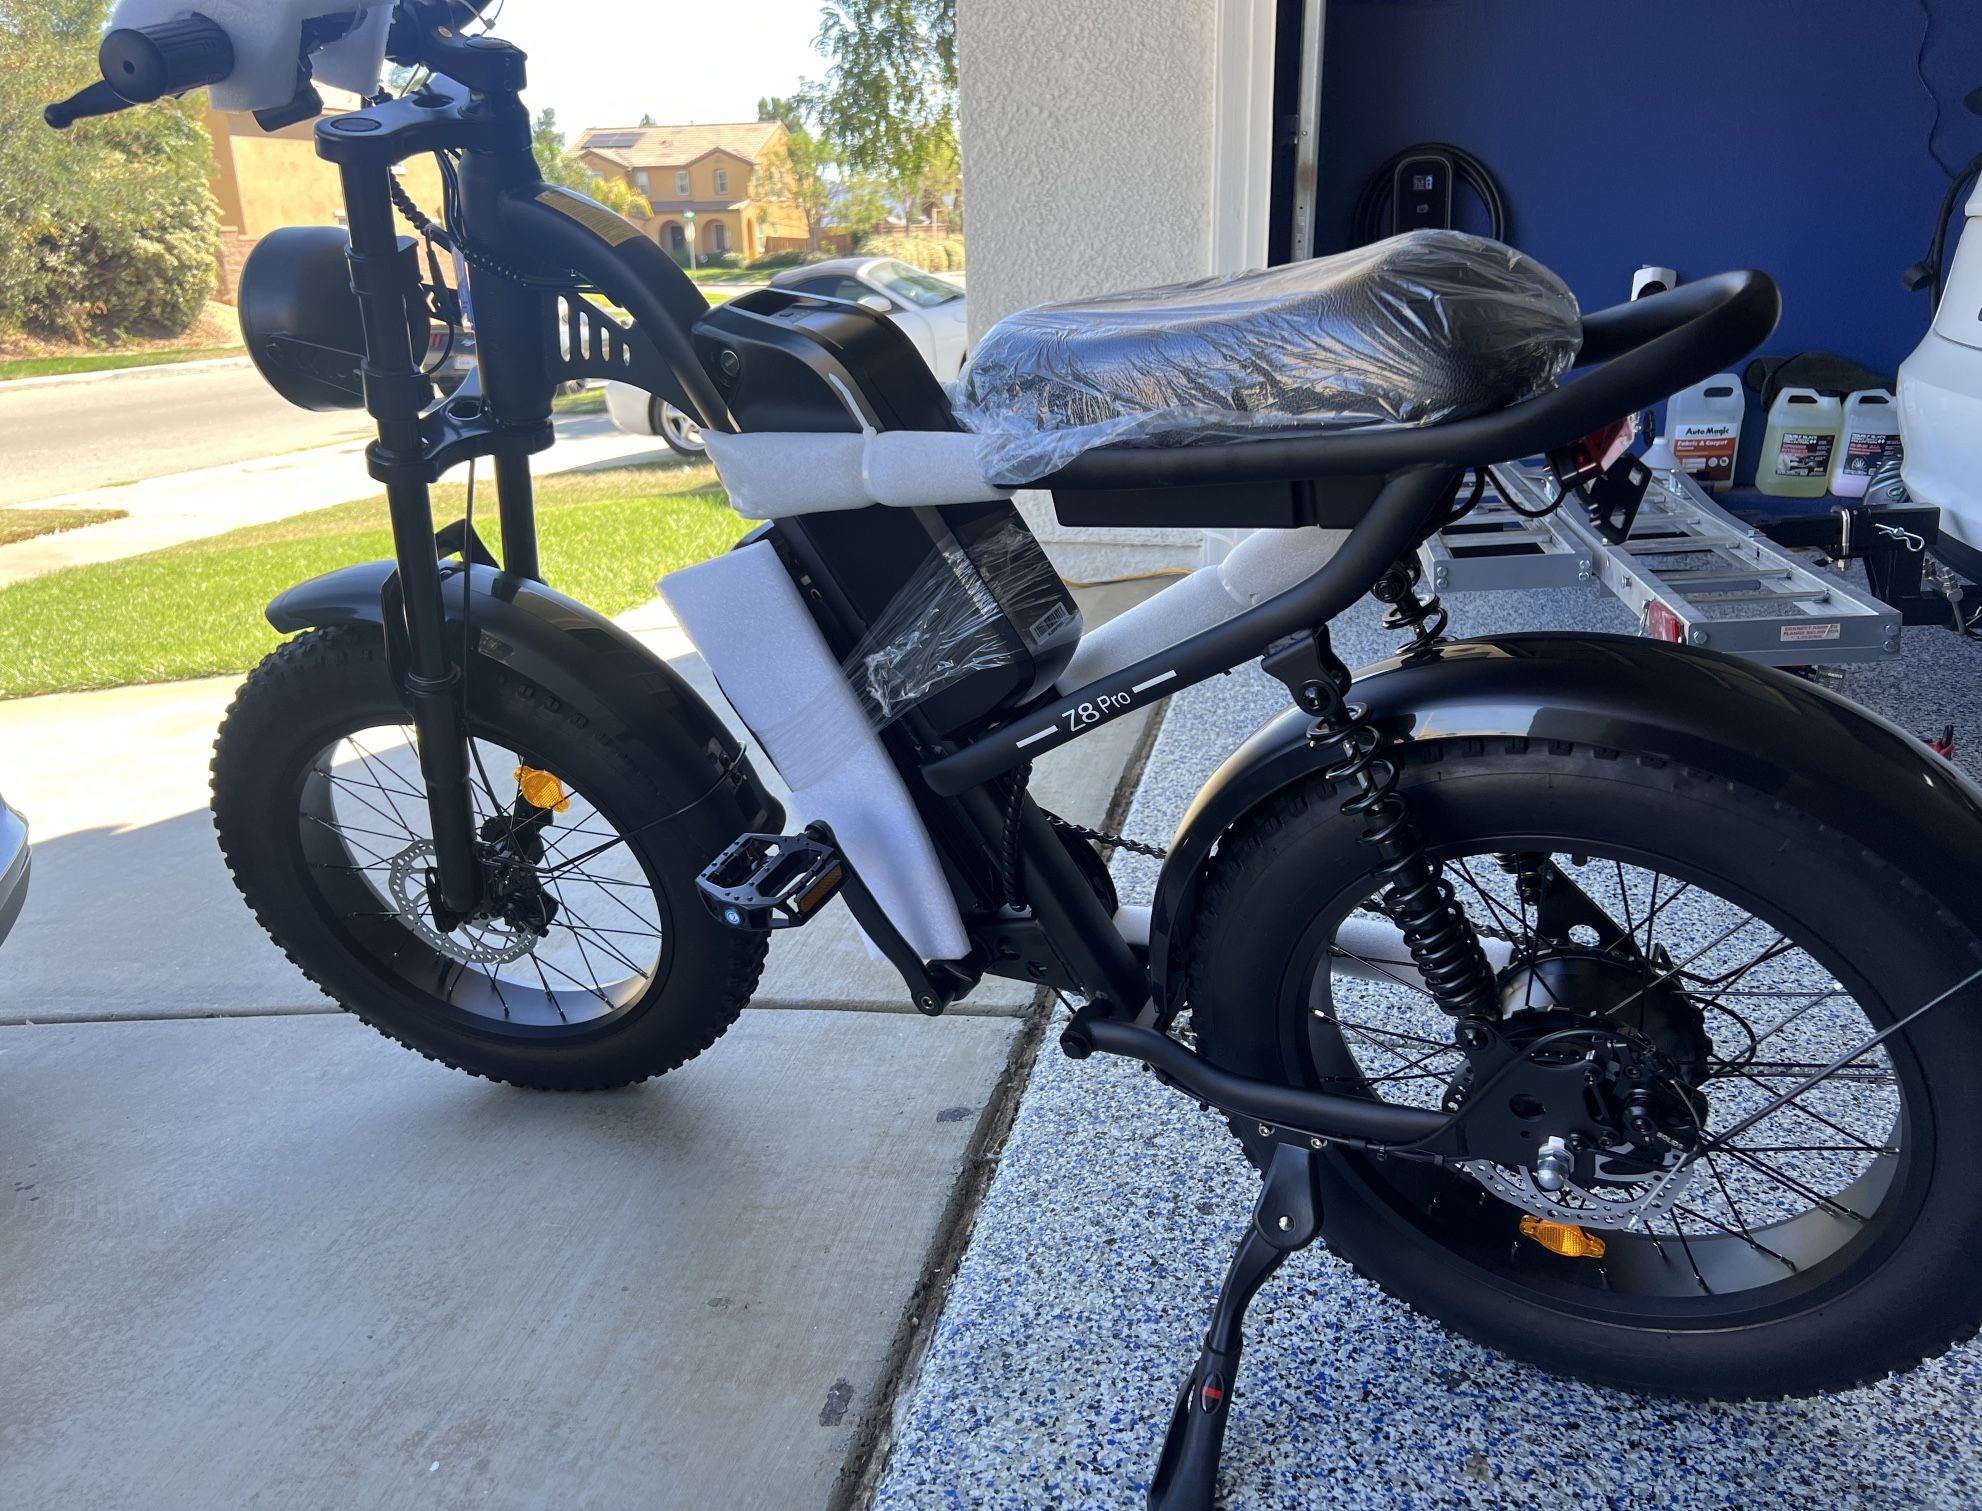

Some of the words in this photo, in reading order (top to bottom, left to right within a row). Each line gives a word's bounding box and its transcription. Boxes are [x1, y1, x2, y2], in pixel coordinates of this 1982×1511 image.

[1685, 427, 1705, 436] Auto
[1705, 426, 1729, 436] Magic
[1705, 439, 1728, 447] Carpet
[1061, 702, 1101, 732] Z8
[1096, 691, 1131, 714] Pro
